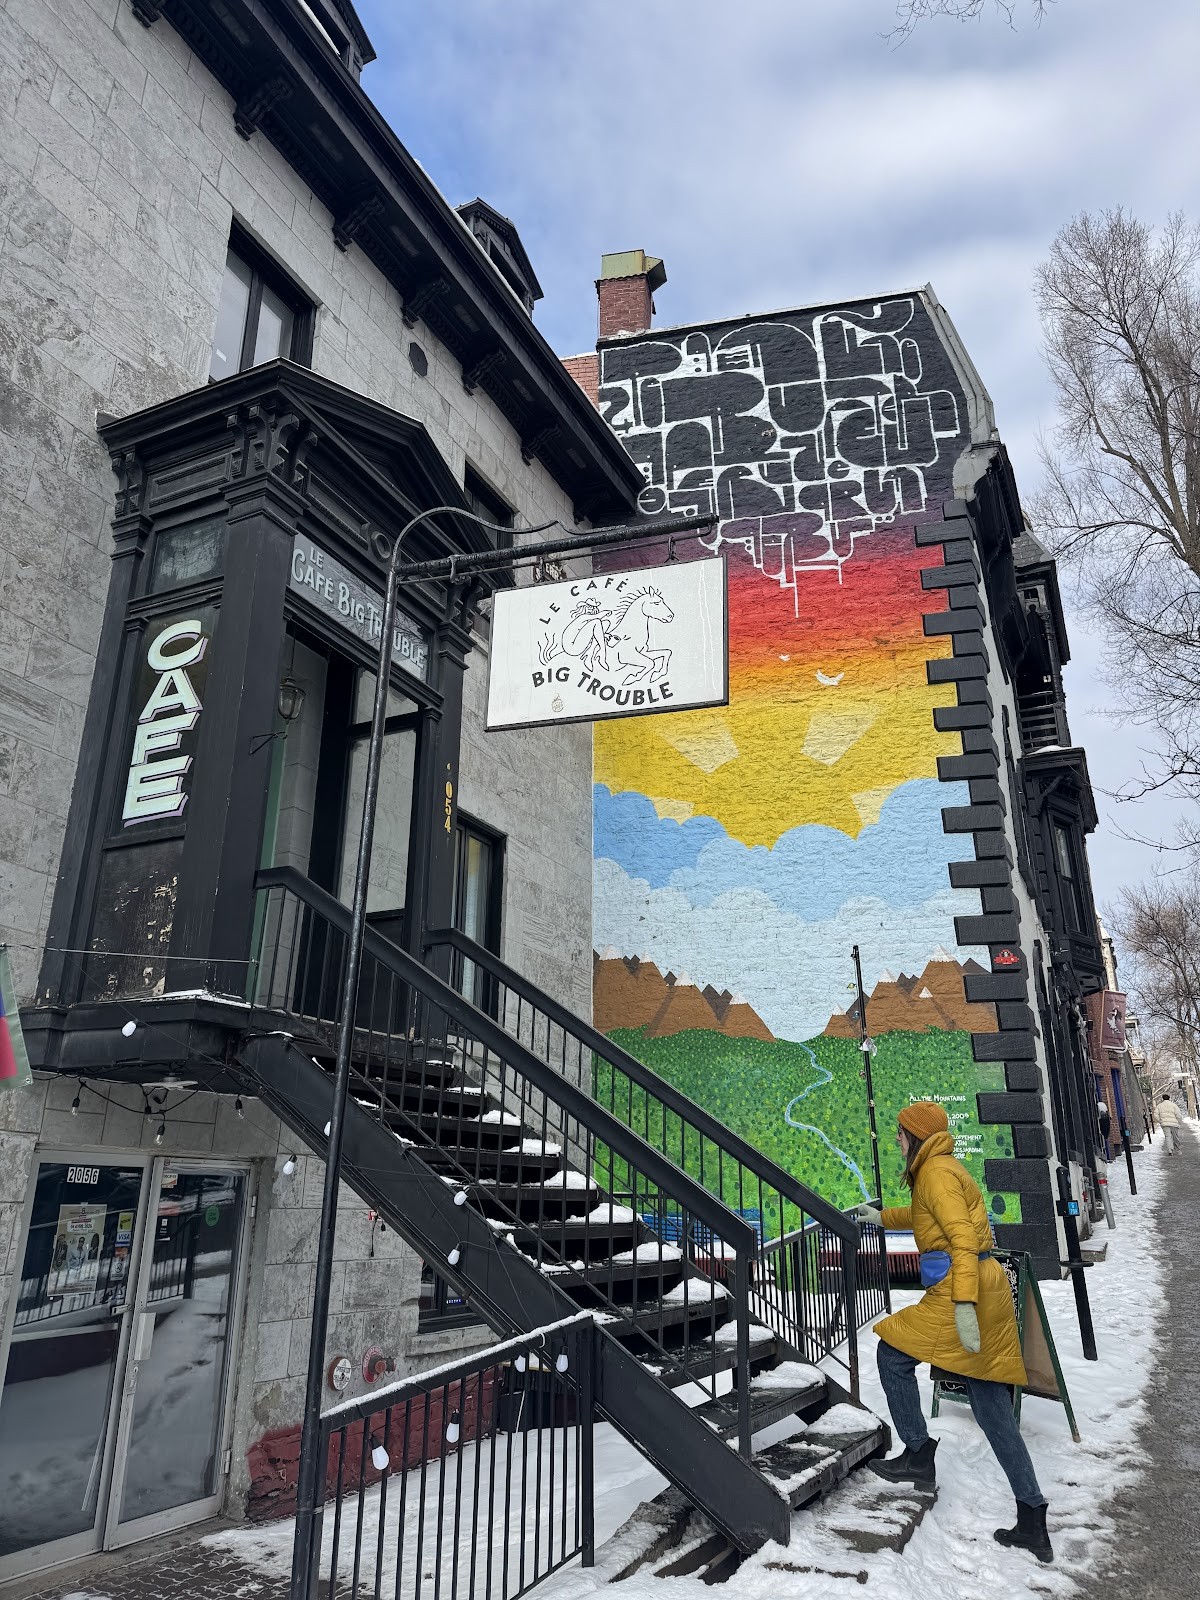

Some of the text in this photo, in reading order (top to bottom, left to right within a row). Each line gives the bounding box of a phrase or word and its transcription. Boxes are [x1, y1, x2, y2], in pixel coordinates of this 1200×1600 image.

[310, 547, 325, 569] LE
[291, 548, 428, 669] CAFÉ BIG TRUBLE
[539, 577, 629, 625] LE CAFÉ
[531, 666, 570, 688] BIG
[576, 671, 674, 706] TROUBLE
[122, 619, 208, 828] CAFE
[444, 763, 453, 834] 054
[68, 1167, 99, 1184] 2056
